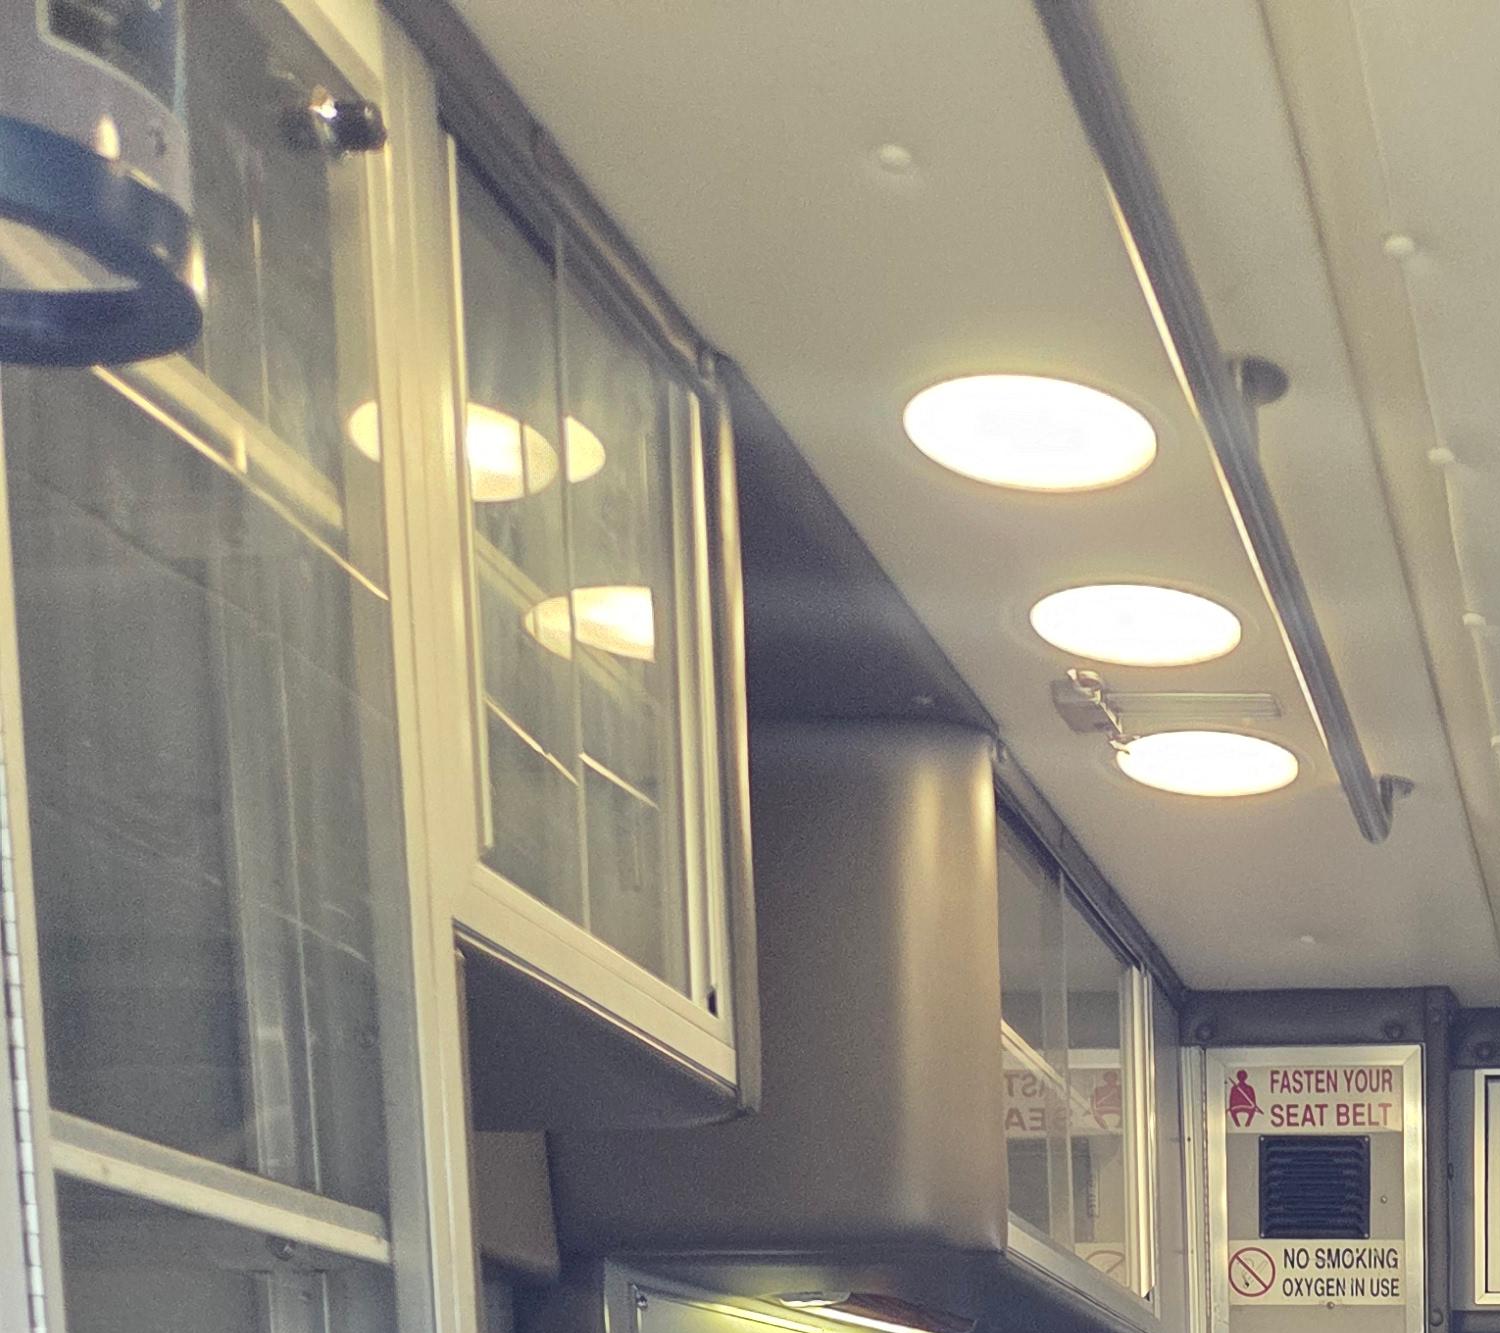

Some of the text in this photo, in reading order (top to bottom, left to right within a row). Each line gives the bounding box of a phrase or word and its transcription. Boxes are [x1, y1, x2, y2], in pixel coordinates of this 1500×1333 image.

[1270, 1068, 1393, 1093] FASTEN YOUR
[1270, 1102, 1392, 1127] SEAT BELT
[1283, 1247, 1399, 1269] NO SMOKING
[1282, 1277, 1400, 1297] OXYGEN IN USE
